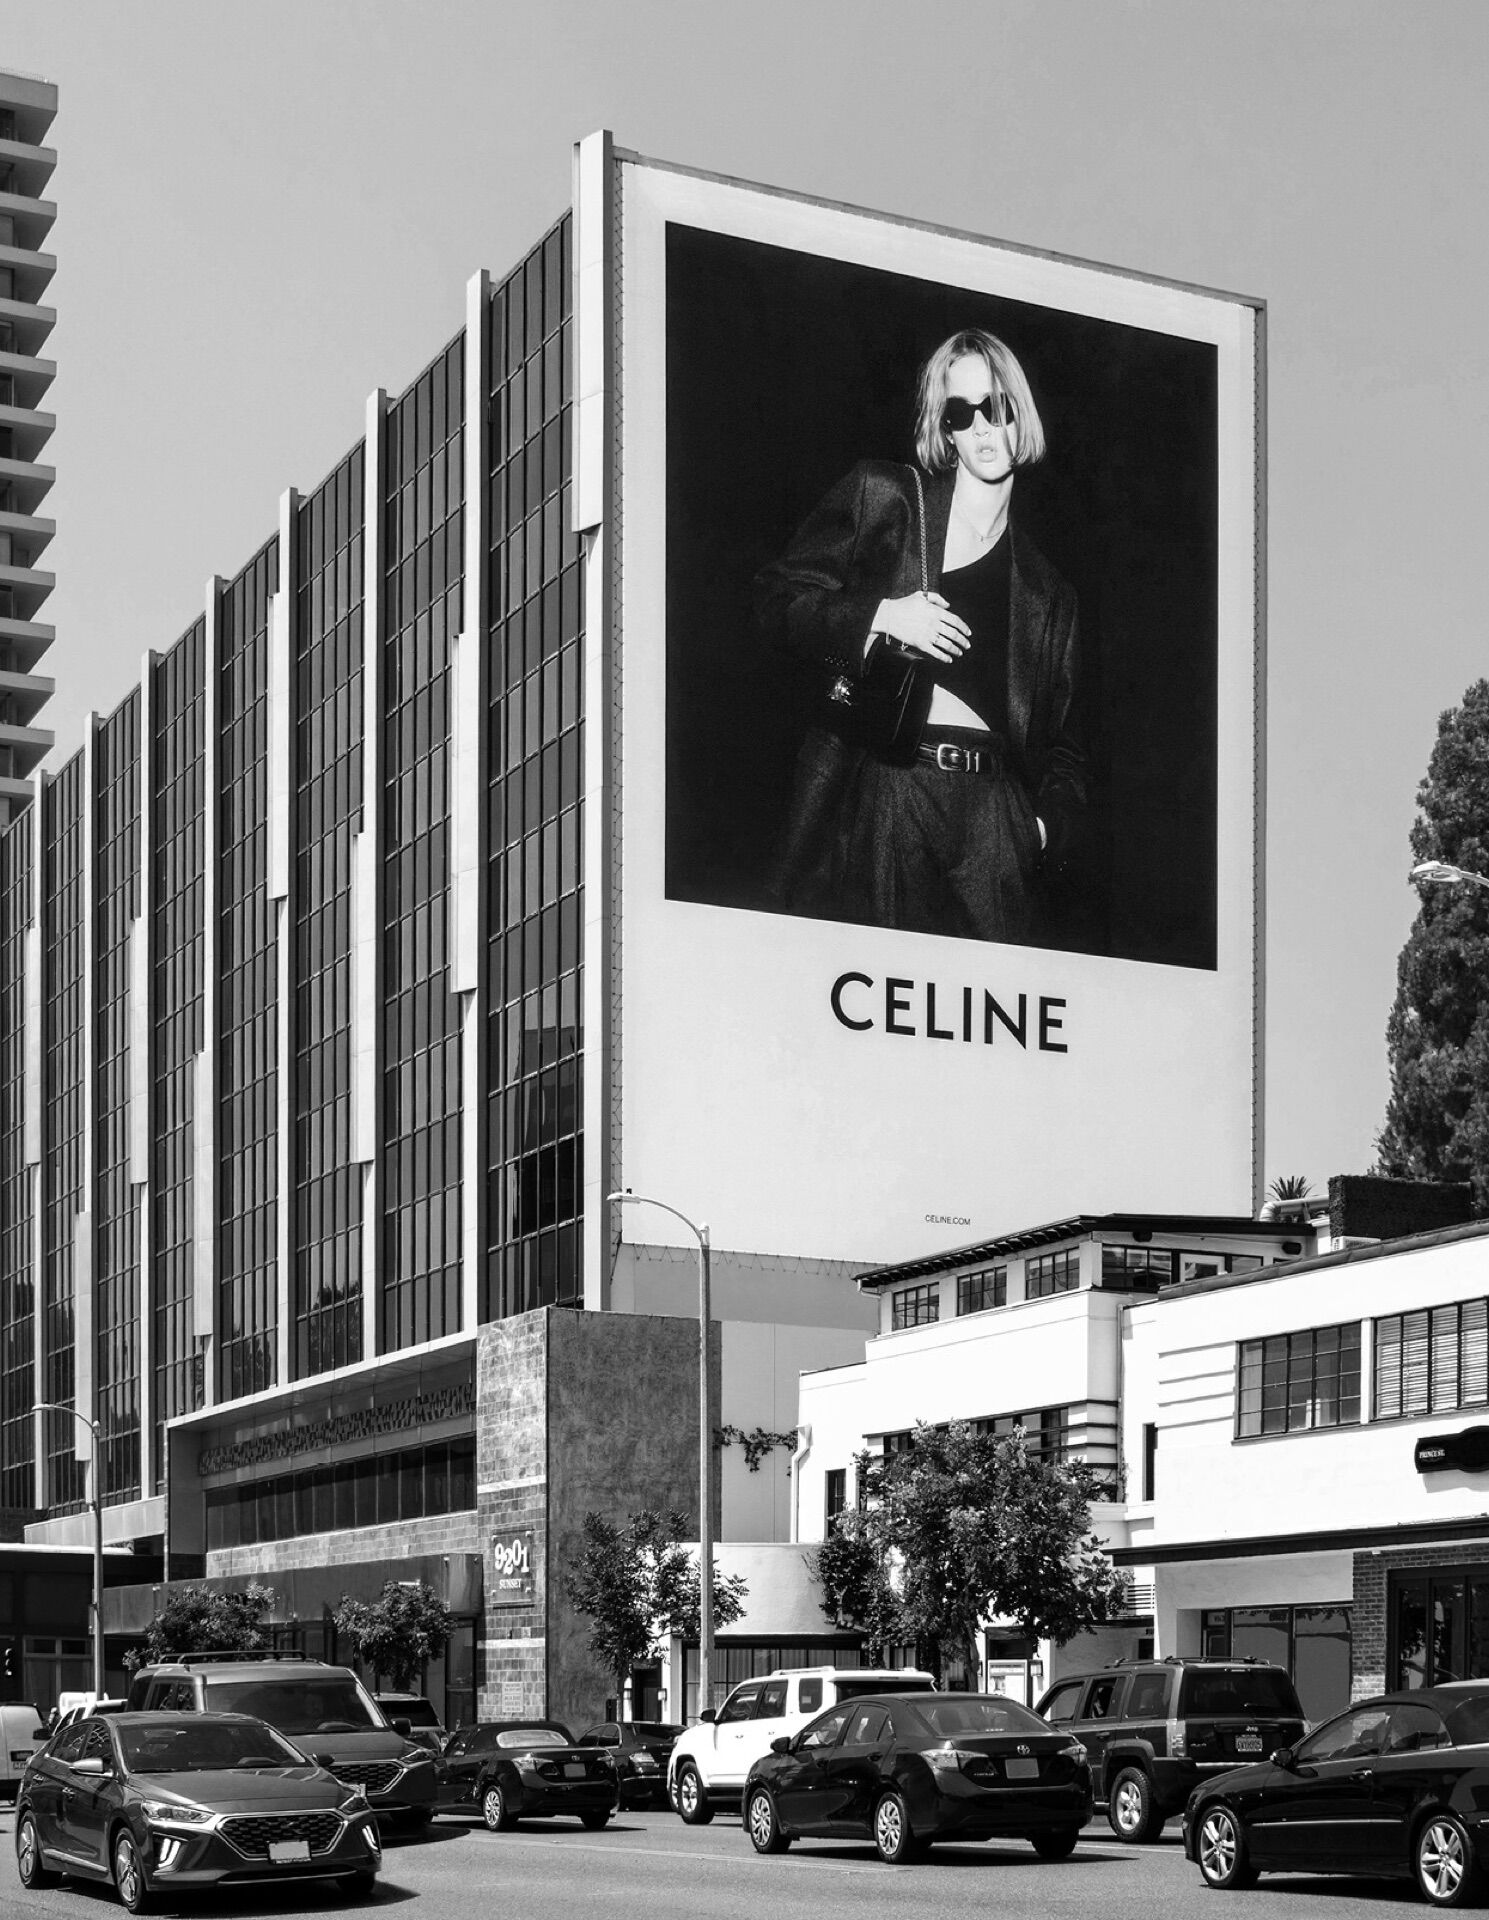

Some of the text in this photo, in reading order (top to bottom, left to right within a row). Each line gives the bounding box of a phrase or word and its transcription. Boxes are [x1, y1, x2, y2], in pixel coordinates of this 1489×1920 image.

[830, 971, 1068, 1053] CELINE
[925, 1214, 971, 1225] CELINE.COM
[494, 1539, 530, 1575] 9201
